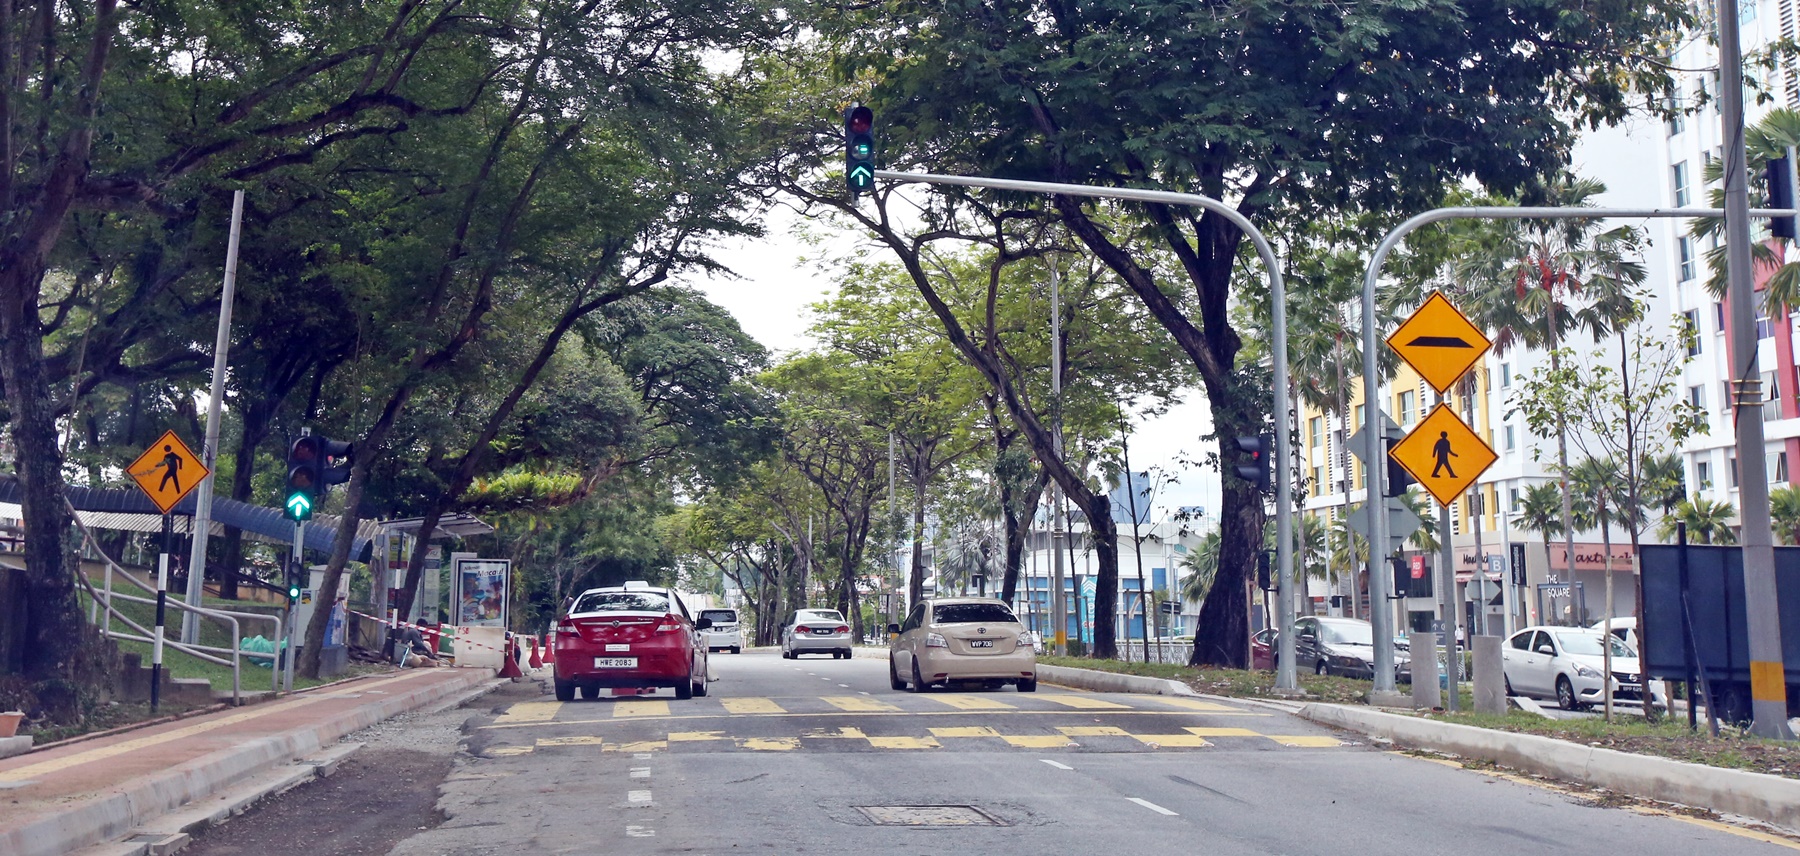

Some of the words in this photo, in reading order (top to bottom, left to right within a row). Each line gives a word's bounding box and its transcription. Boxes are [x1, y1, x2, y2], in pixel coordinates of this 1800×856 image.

[1493, 559, 1502, 571] B
[1546, 574, 1558, 584] THE
[1547, 587, 1571, 598] SQUARE
[600, 659, 613, 667] HWE
[615, 659, 632, 667] 2083
